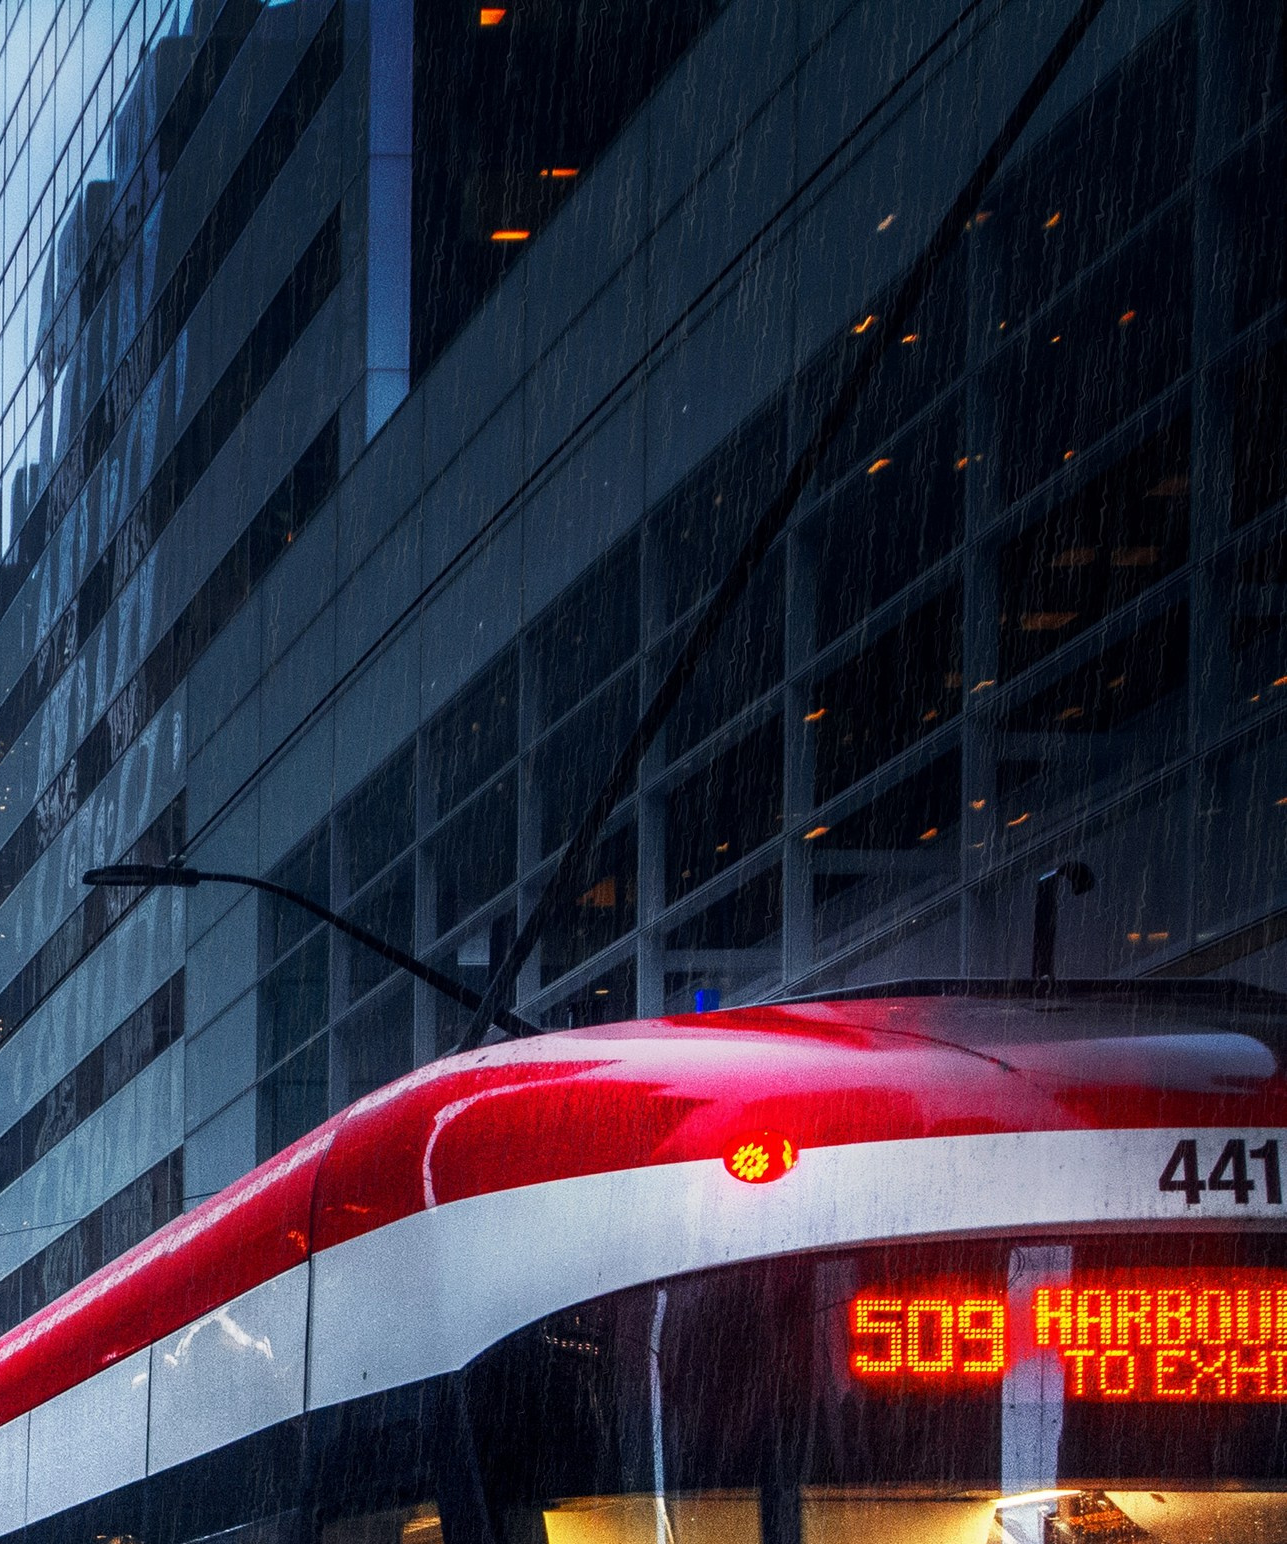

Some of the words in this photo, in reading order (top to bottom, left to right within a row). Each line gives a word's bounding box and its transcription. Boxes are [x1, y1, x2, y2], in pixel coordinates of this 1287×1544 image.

[1158, 1139, 1282, 1204] 441
[855, 1299, 1005, 1372] 509
[1063, 1350, 1135, 1395] TO
